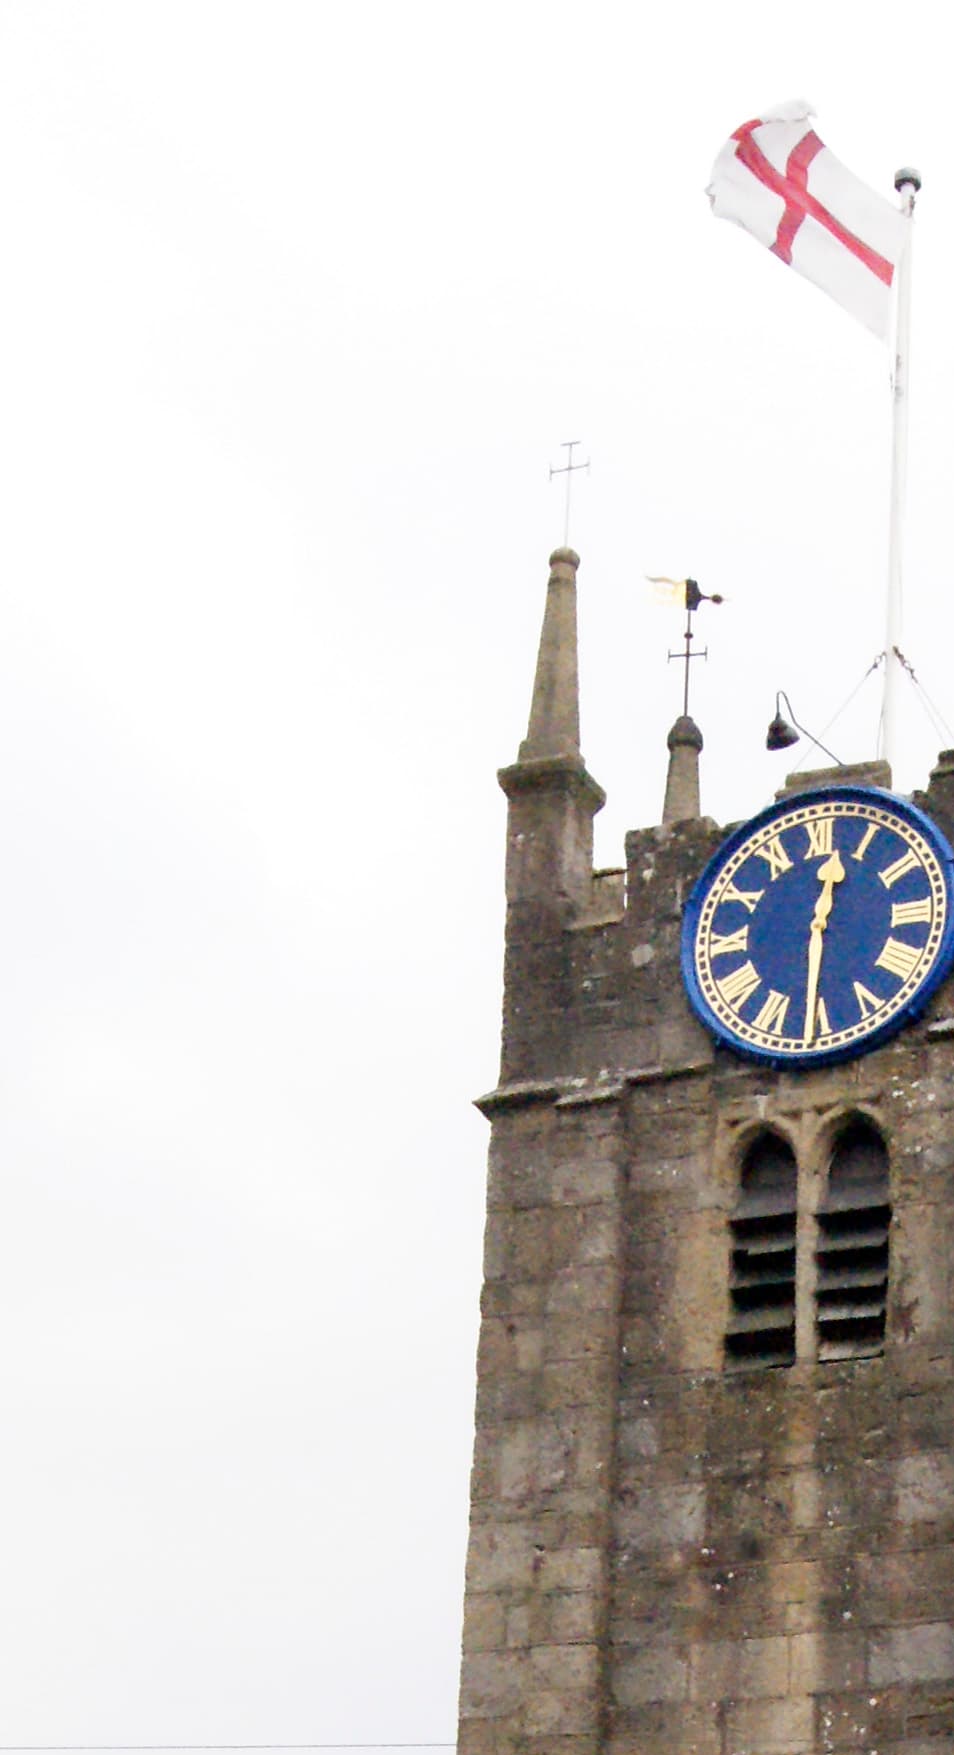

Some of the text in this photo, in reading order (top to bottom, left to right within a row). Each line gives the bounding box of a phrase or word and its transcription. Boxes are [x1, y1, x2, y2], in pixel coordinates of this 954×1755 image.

[752, 835, 795, 881] XI
[803, 817, 836, 860] XII
[851, 822, 881, 861] I
[878, 848, 923, 889] II
[720, 881, 765, 913] X
[891, 896, 931, 928] III
[853, 981, 886, 1019] V
